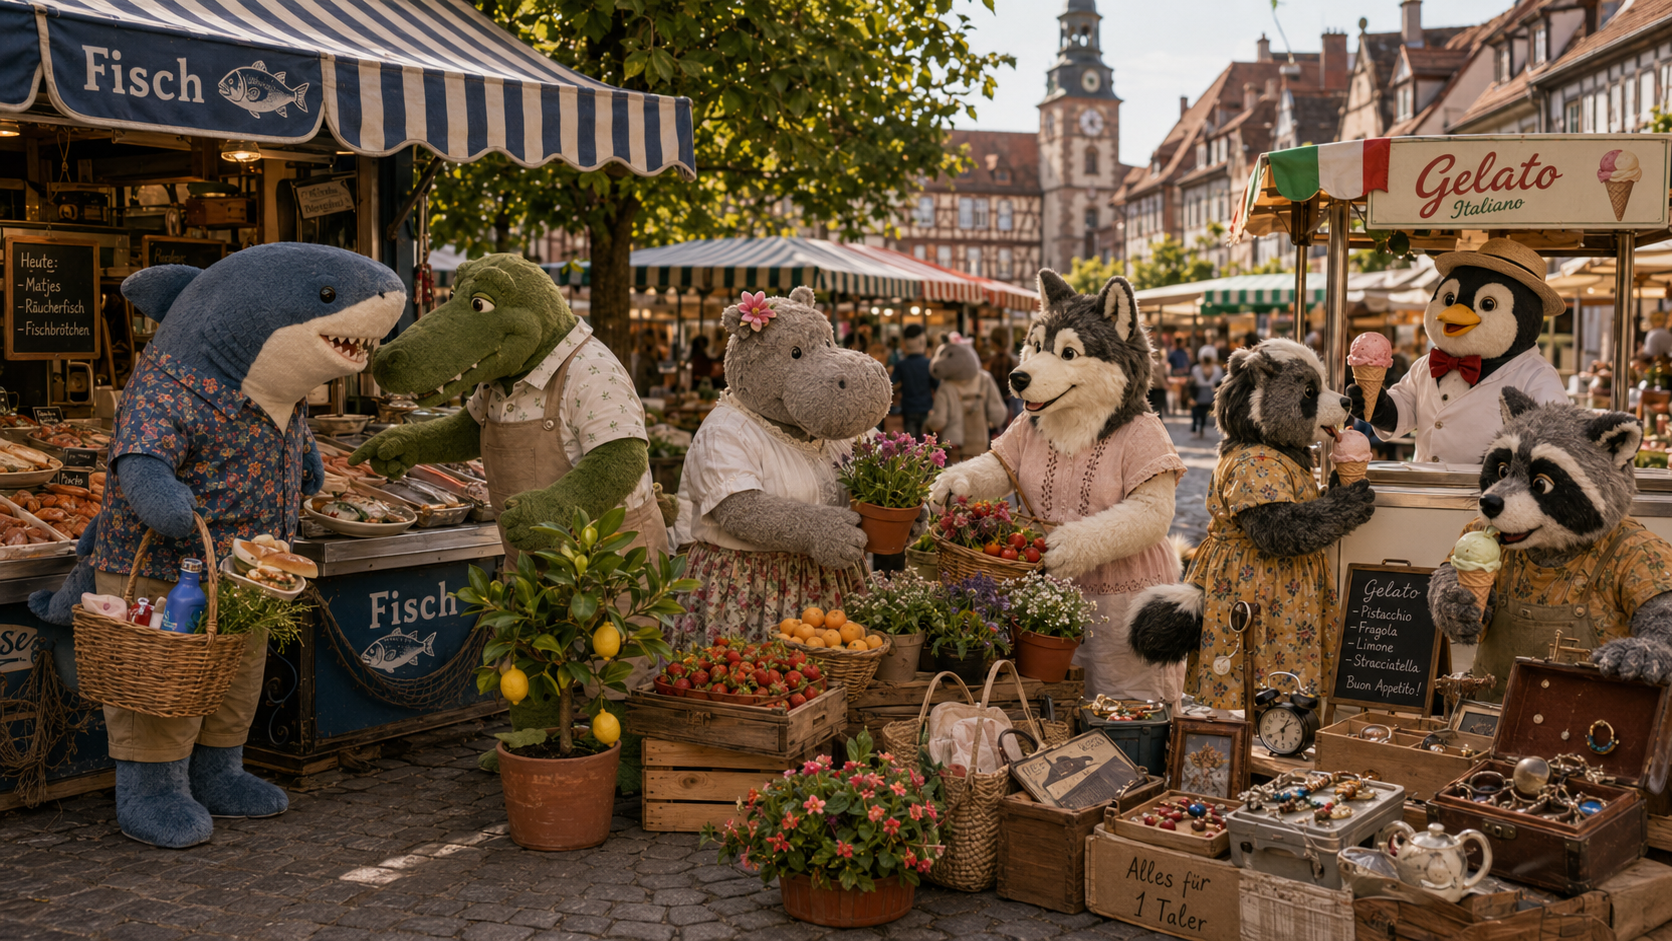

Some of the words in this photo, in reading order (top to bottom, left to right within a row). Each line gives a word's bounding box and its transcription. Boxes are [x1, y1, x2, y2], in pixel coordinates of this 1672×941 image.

[82, 44, 204, 103] Fisch
[1415, 151, 1563, 219] Gelato
[1450, 197, 1525, 219] Italiano
[20, 251, 58, 270] Heute:
[369, 580, 458, 629] Fisch
[1363, 579, 1420, 603] Gelato
[1346, 675, 1371, 691] Buon
[1374, 679, 1422, 698] Appetito!
[1126, 856, 1173, 888] Alles
[1183, 871, 1211, 898] für
[1134, 891, 1146, 917] 1
[1156, 898, 1207, 931] Taler
